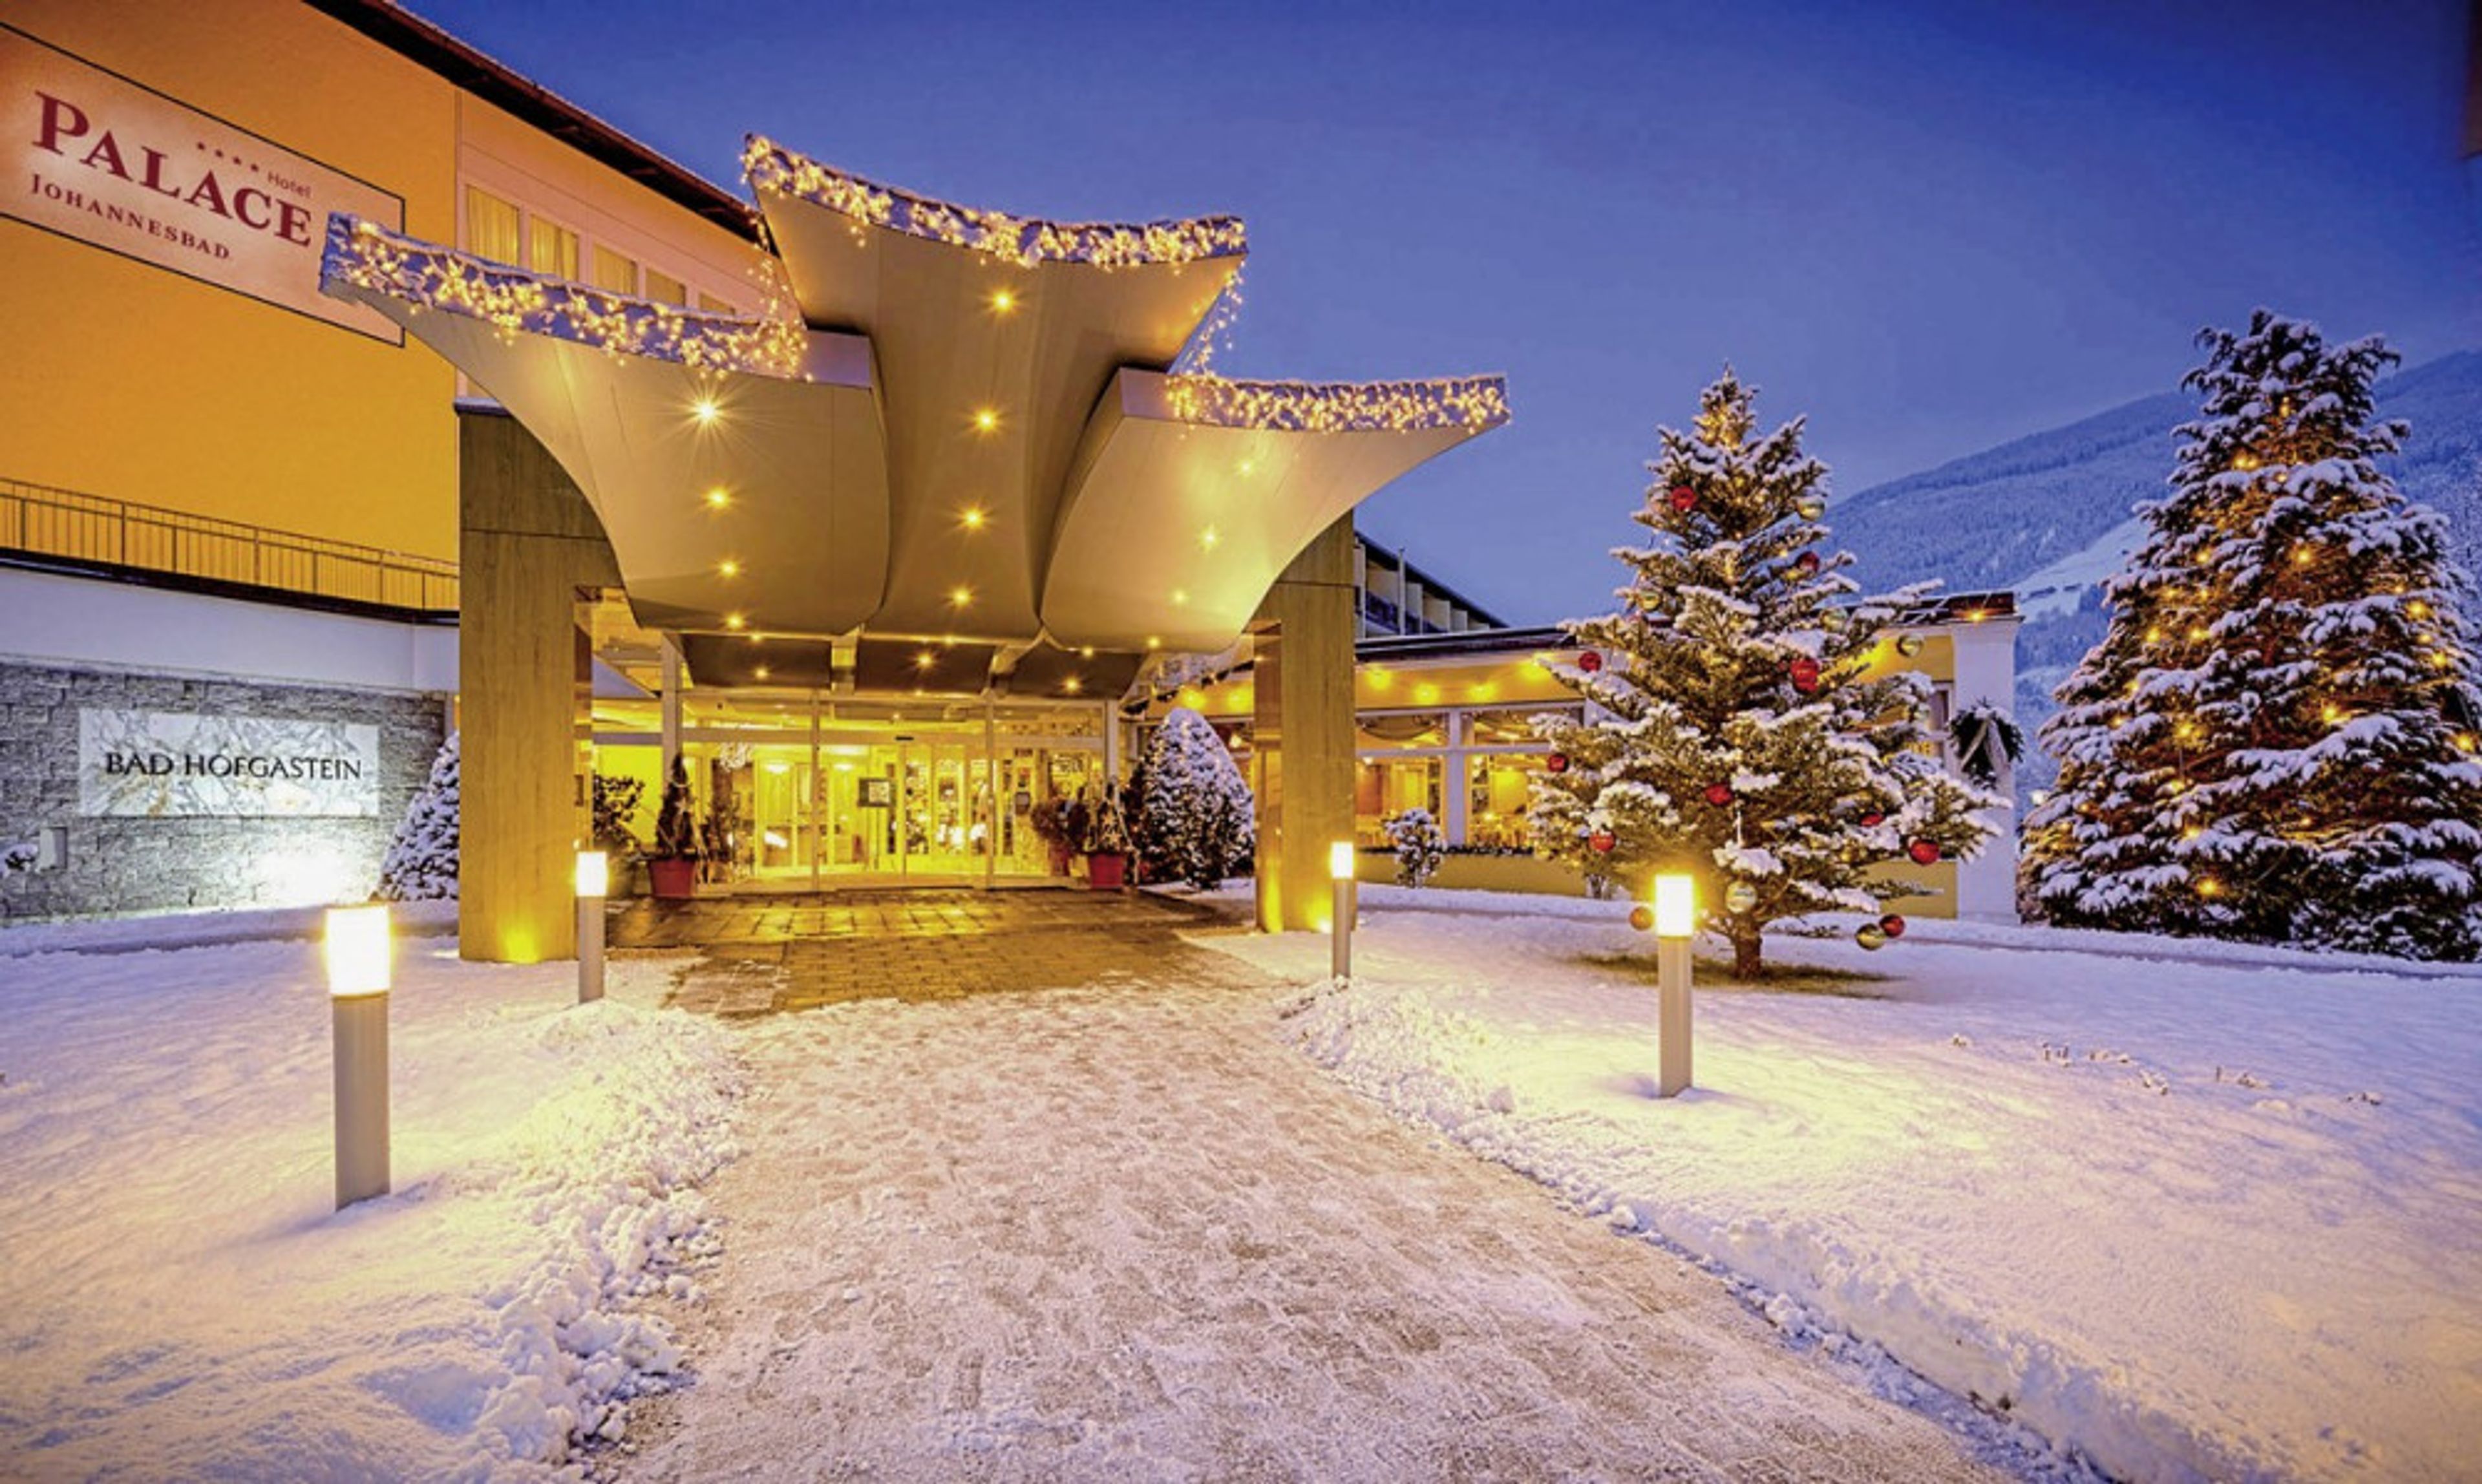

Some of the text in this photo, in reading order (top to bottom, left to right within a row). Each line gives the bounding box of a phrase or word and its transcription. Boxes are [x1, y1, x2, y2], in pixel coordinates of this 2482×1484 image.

[32, 91, 312, 247] PALACE
[268, 171, 312, 198] Hotel
[31, 173, 230, 260] JOHANNESBAD
[106, 752, 361, 780] BAD HOFGASTEIN
